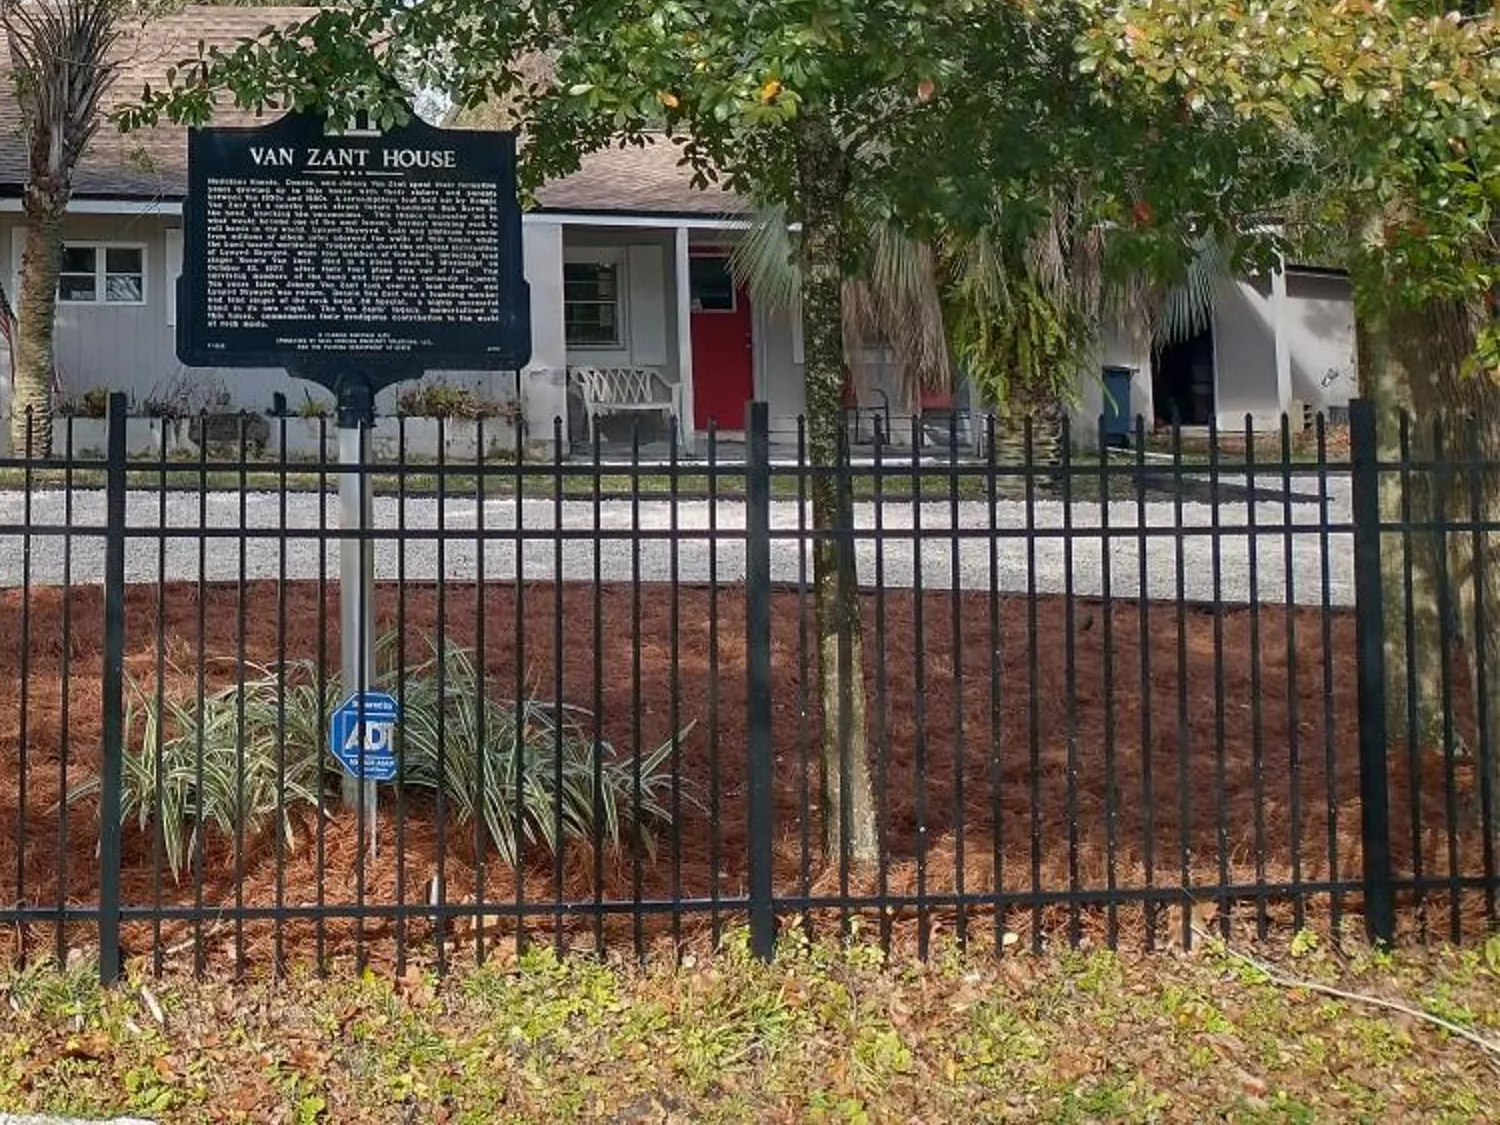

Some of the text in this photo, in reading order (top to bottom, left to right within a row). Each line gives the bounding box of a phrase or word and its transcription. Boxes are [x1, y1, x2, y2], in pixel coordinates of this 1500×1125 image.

[250, 147, 457, 168] VAN ZANT HOUSE
[345, 721, 395, 751] ADT
